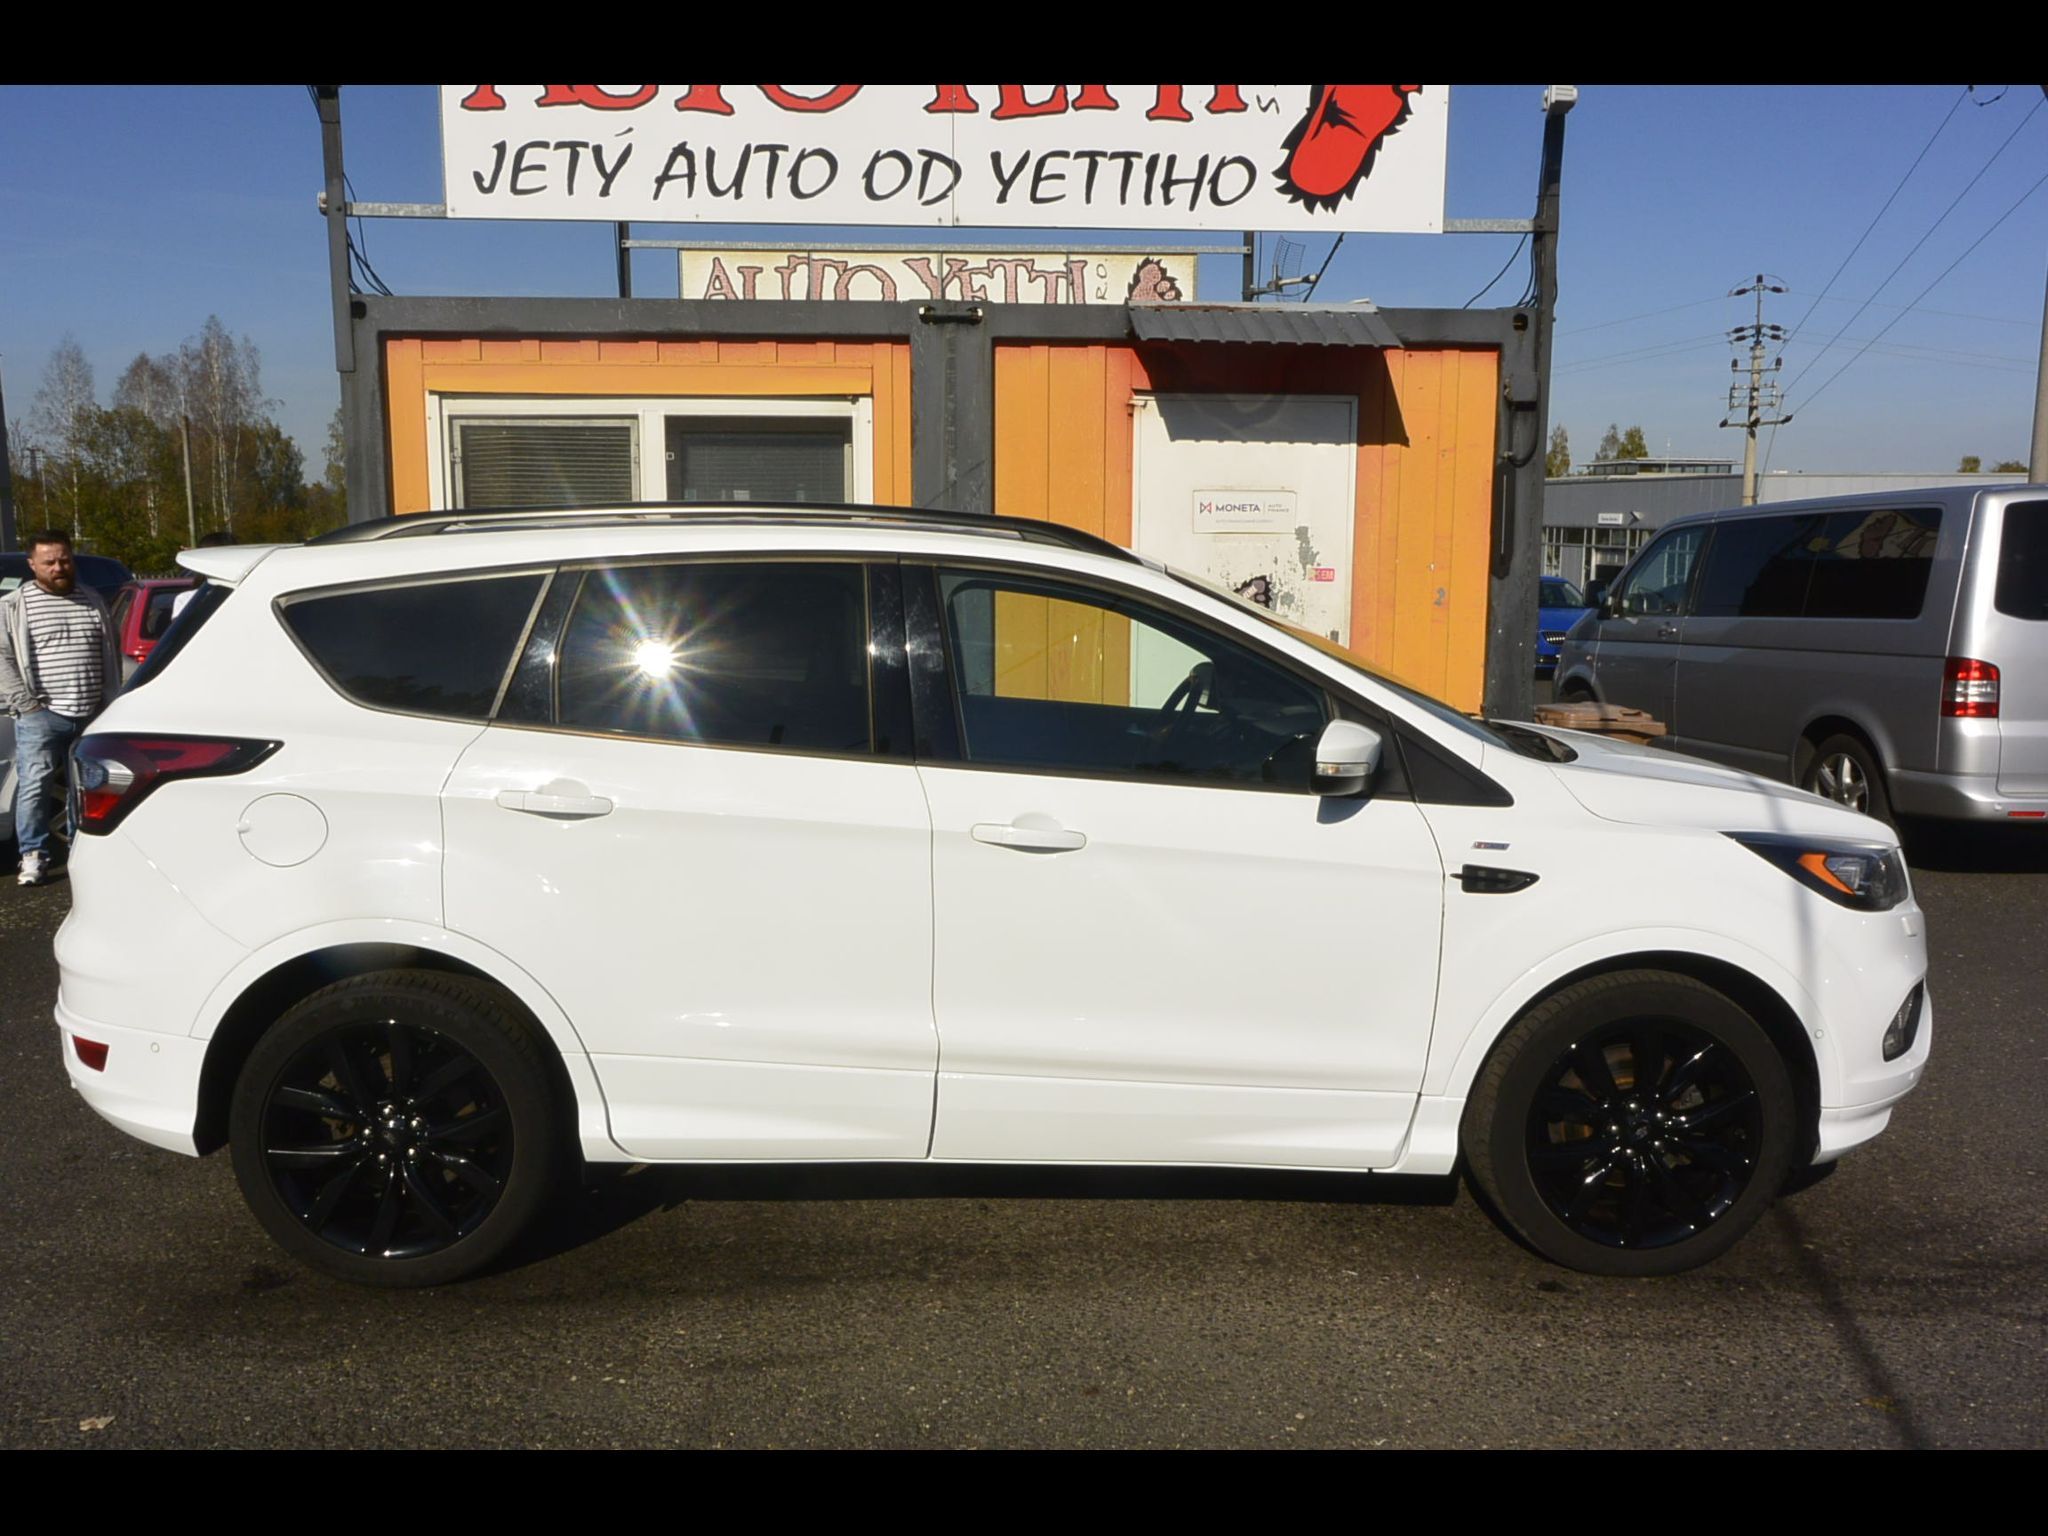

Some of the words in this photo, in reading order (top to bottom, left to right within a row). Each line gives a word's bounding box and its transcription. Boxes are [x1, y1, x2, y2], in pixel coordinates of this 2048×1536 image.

[472, 127, 634, 198] JETÝ
[652, 140, 839, 201] AUTO
[861, 147, 963, 206] OD
[989, 149, 1258, 212] YETTIHO
[1215, 503, 1261, 513] MONETA
